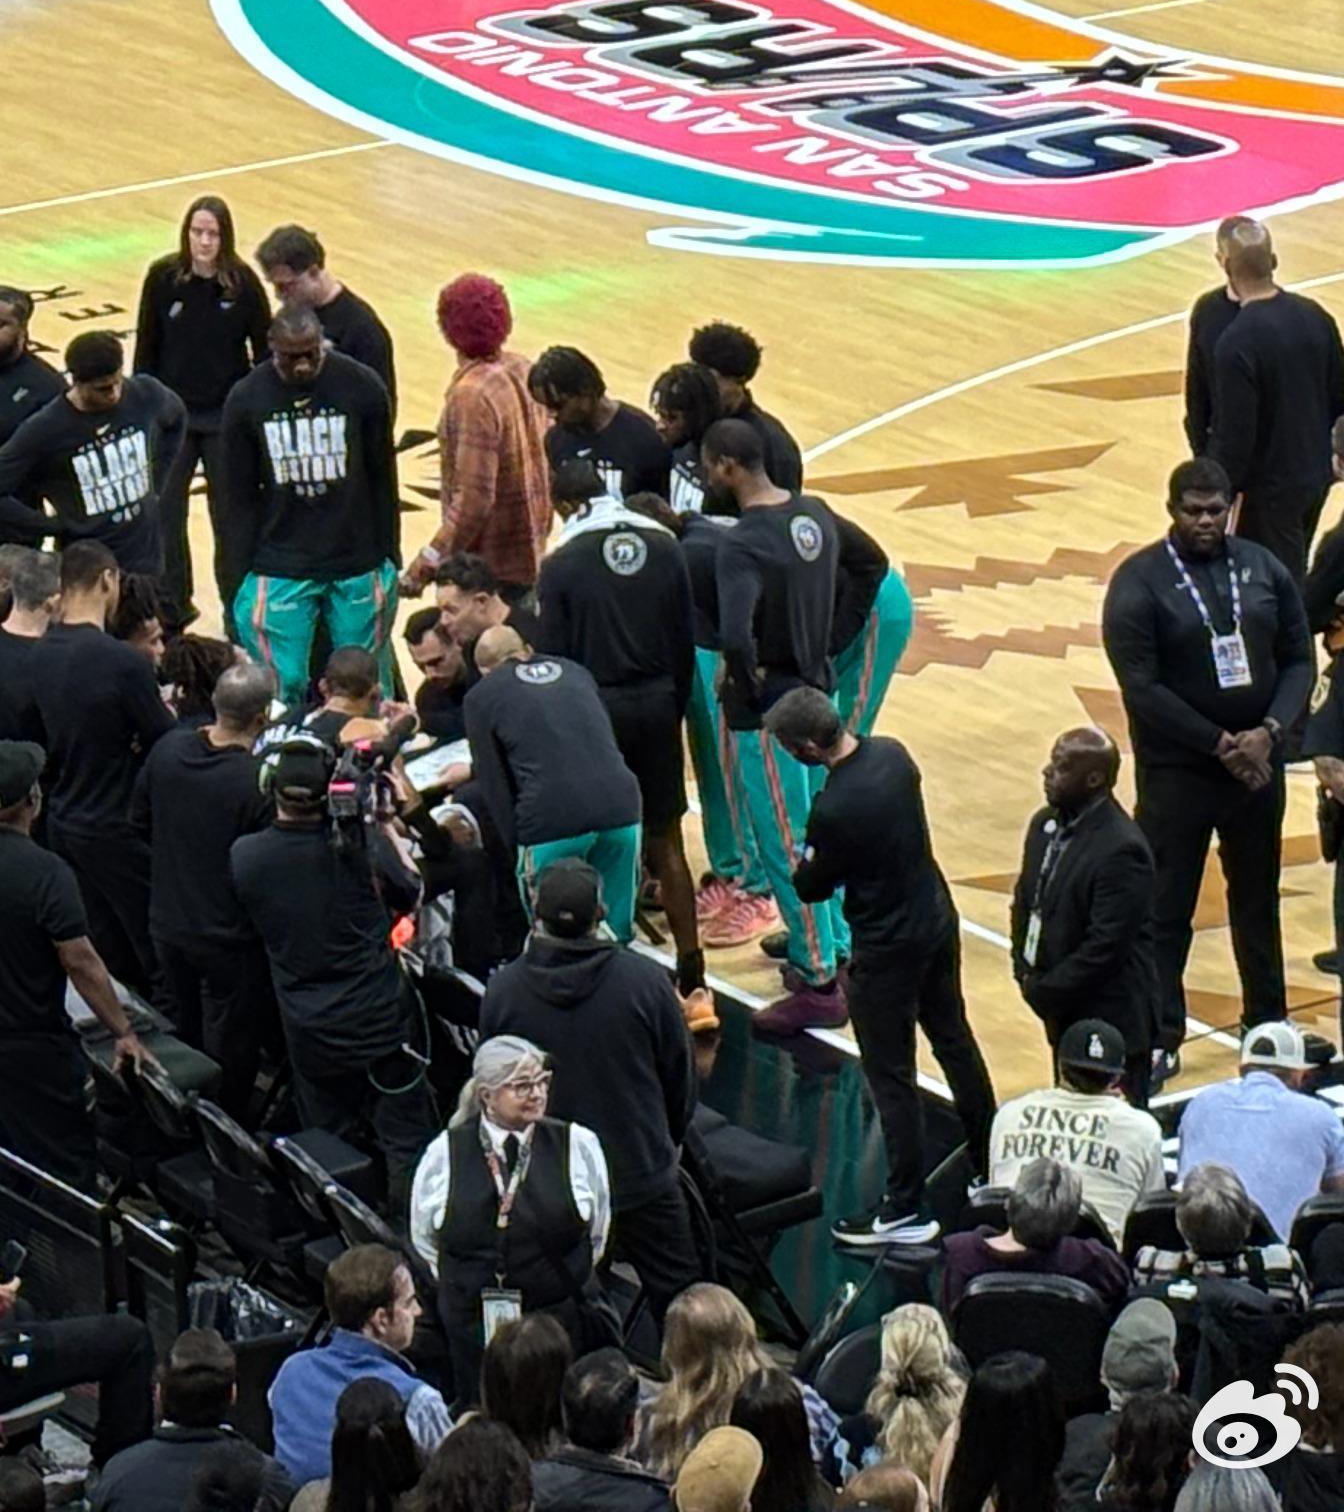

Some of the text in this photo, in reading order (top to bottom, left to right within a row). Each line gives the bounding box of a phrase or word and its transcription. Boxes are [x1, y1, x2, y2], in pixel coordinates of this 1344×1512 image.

[418, 30, 970, 199] SAN ANTONIO
[263, 414, 346, 460] BLACK
[72, 430, 148, 489] BLACK
[270, 451, 346, 485] HISTORY
[1019, 1105, 1110, 1138] SINCE
[1002, 1133, 1121, 1174] FOREVER
